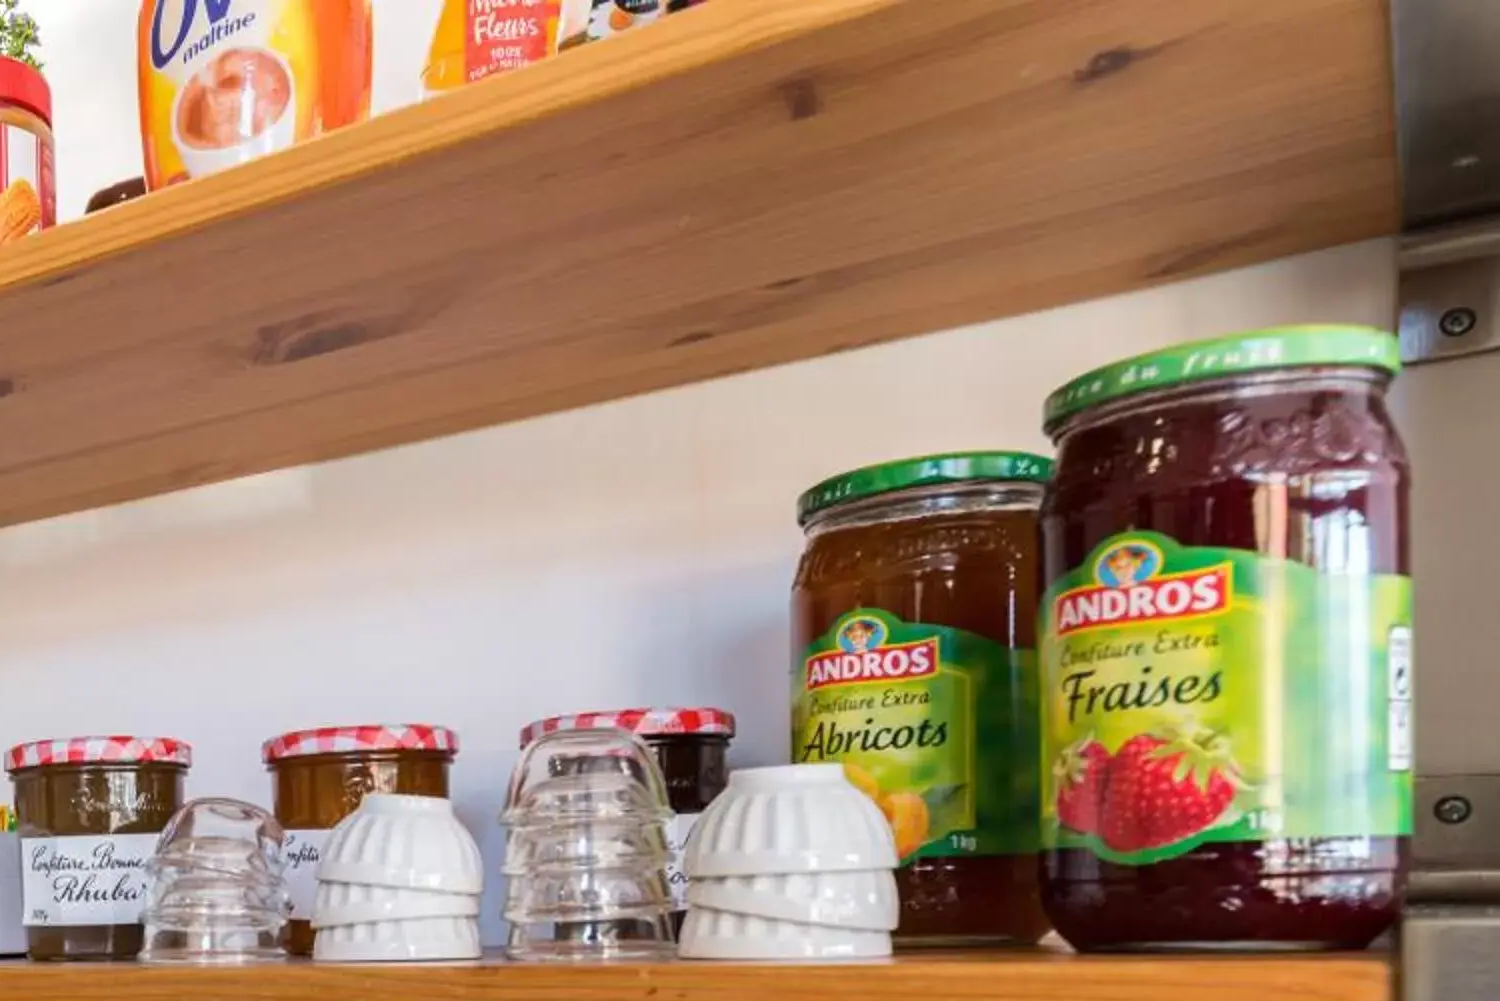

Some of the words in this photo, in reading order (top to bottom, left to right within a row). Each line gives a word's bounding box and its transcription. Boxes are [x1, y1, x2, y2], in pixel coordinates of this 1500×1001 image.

[183, 12, 256, 64] maltine
[474, 11, 539, 45] Fleurs
[1059, 574, 1221, 629] ANDROS
[809, 645, 931, 685] ANDROS
[1060, 641, 1146, 668] Confiture
[1153, 629, 1221, 655] Extra
[811, 695, 876, 716] Confiture
[881, 688, 931, 708] Extra
[1062, 666, 1223, 727] Fraises
[802, 717, 949, 763] Abricots
